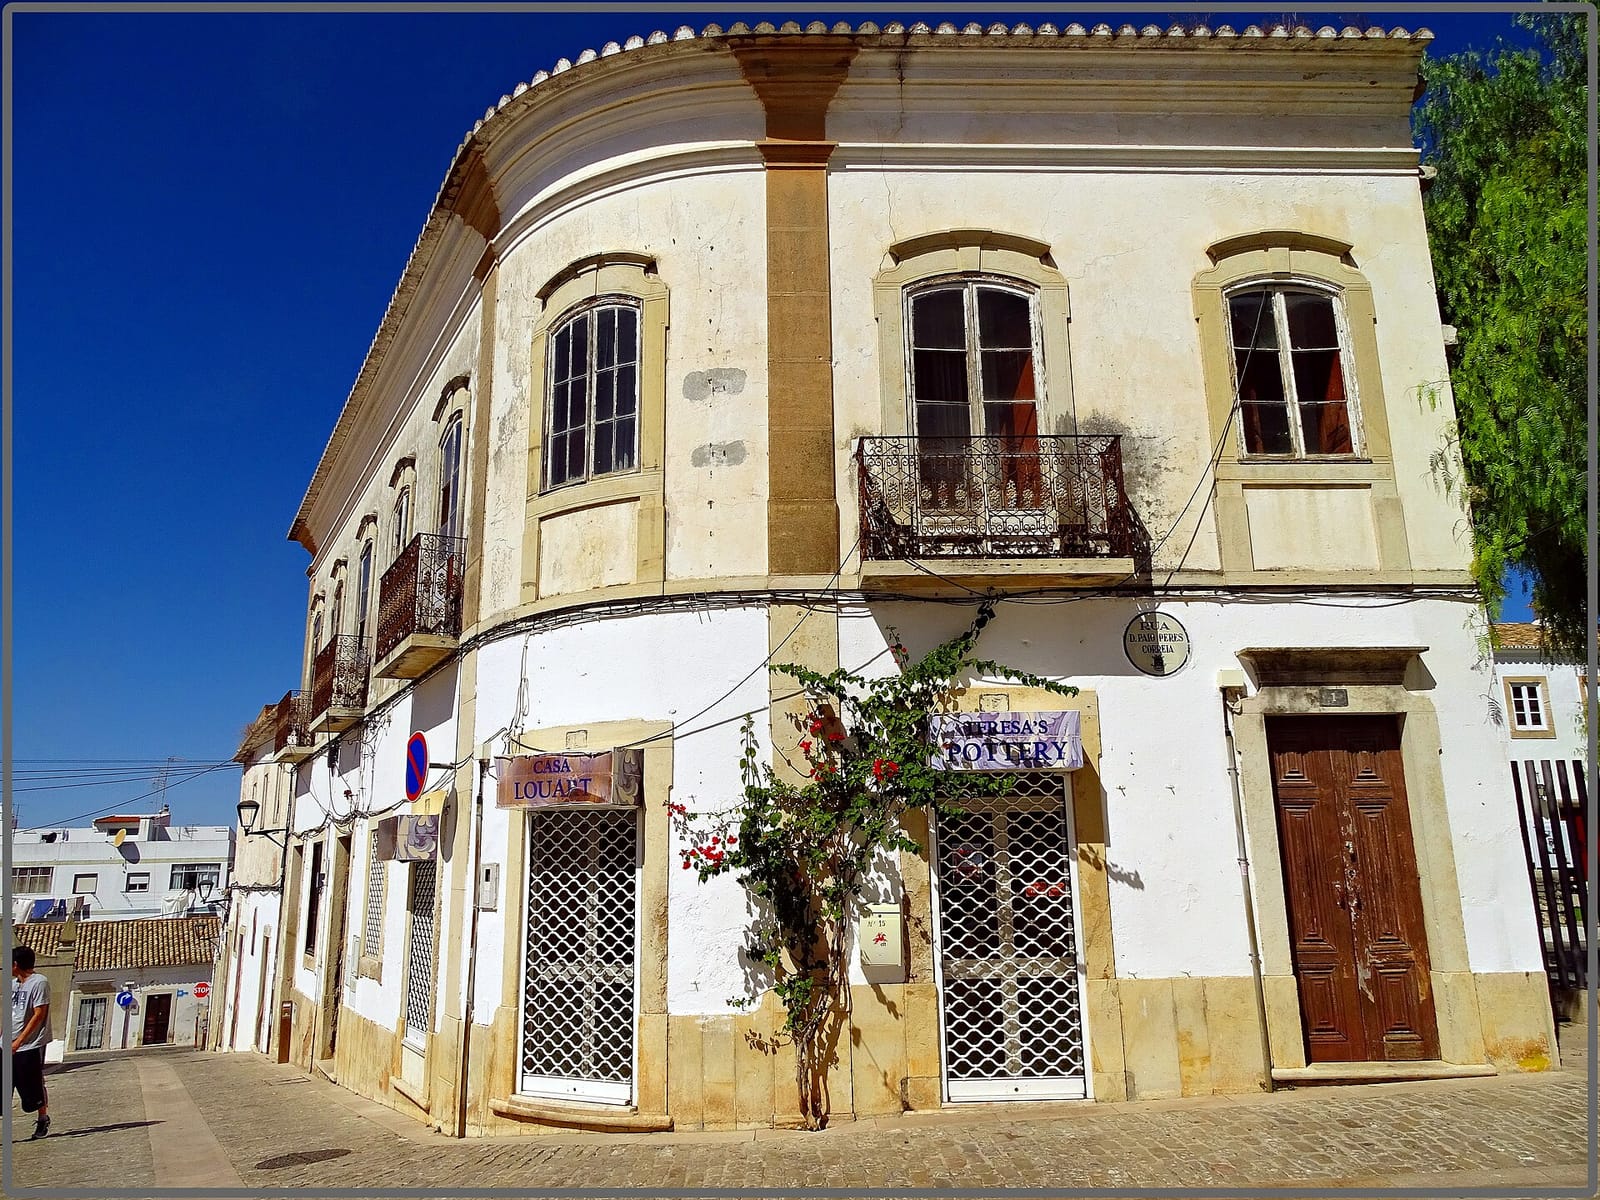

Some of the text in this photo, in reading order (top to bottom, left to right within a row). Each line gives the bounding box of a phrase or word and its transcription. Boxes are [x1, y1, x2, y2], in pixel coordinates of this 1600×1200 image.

[1140, 621, 1170, 631] RUA
[1158, 633, 1184, 642] PERES
[1141, 644, 1174, 654] CORREIA
[1330, 692, 1337, 702] 1
[963, 719, 1048, 736] TERESA'S
[946, 741, 1067, 762] POTTERY
[533, 758, 571, 774] CASA
